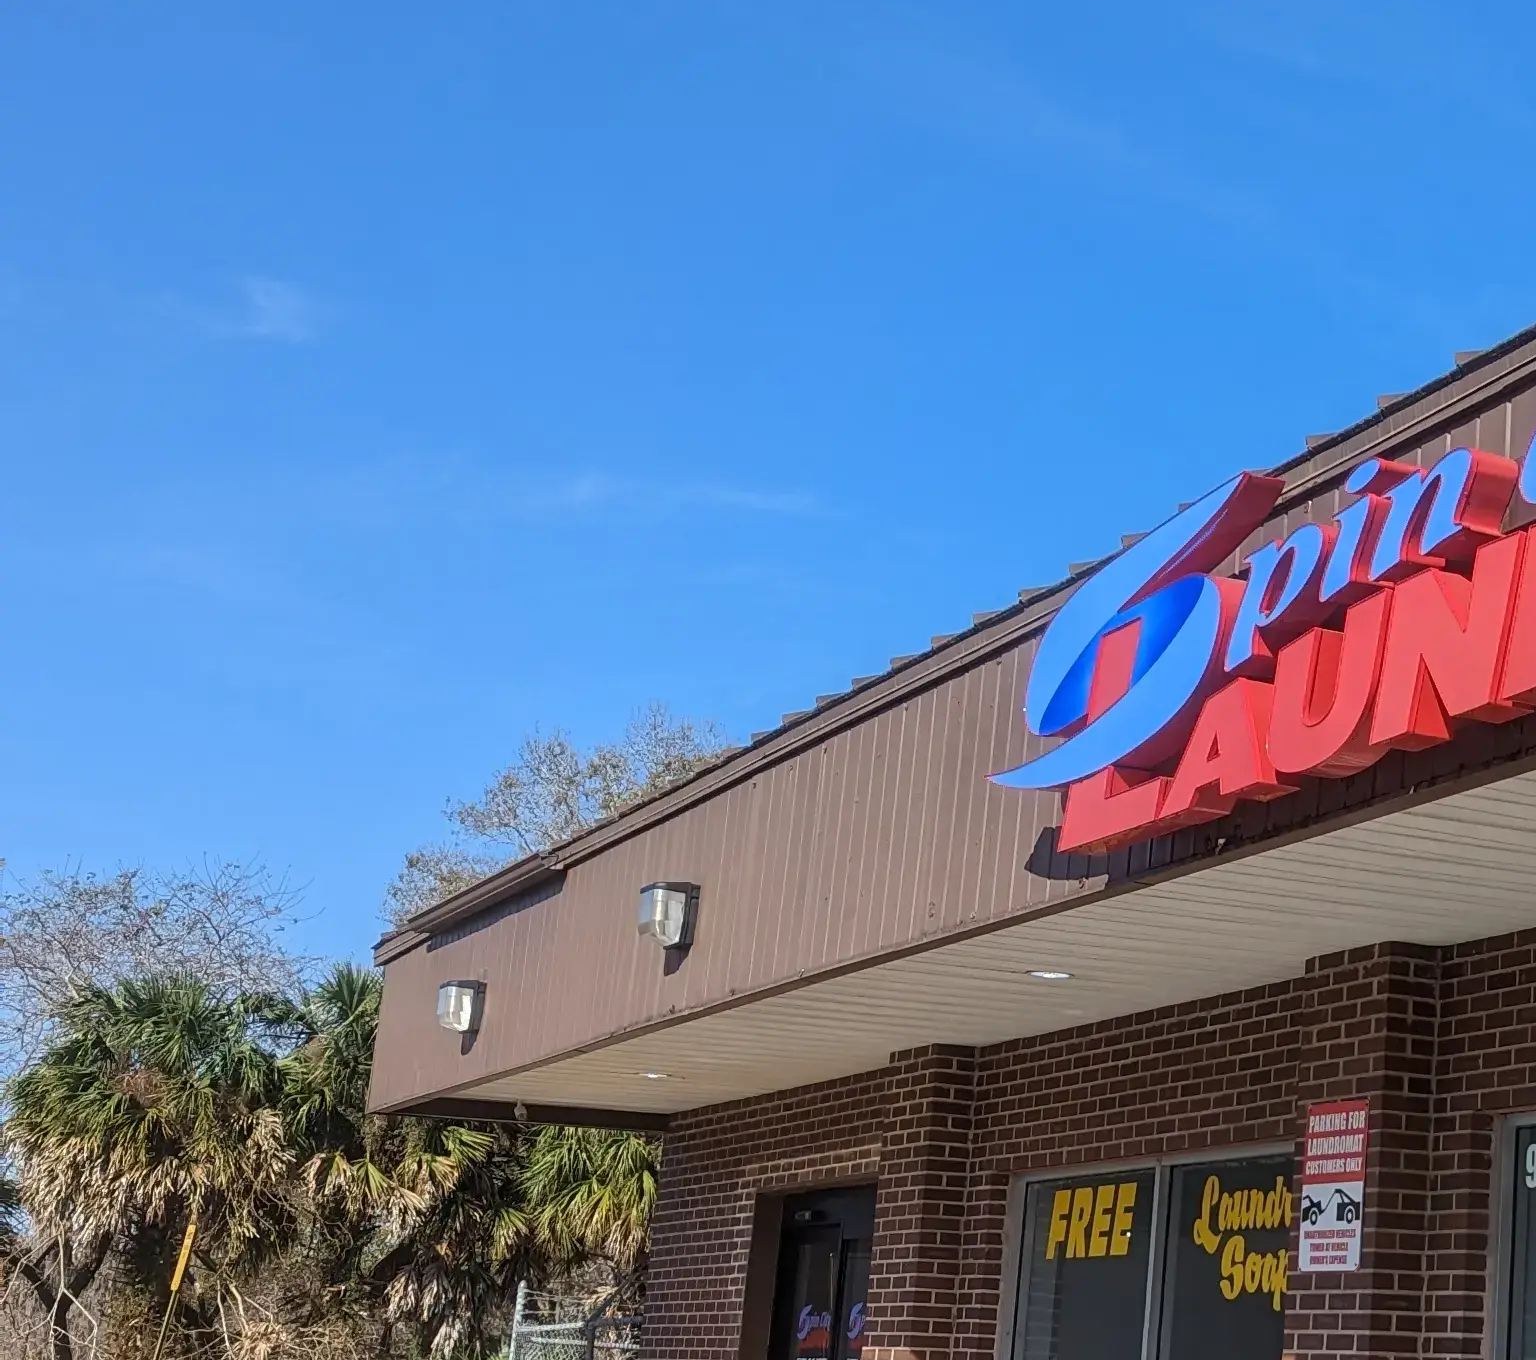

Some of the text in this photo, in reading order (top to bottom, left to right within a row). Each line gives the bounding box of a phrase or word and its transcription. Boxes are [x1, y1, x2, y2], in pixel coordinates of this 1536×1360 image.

[1308, 1110, 1366, 1134] PARKING FOR
[1307, 1134, 1365, 1157] LAUNDROMAT
[1305, 1157, 1363, 1175] CUSTOMERS ONLY
[1046, 1182, 1138, 1260] FREE
[1193, 1175, 1293, 1254] Laundr
